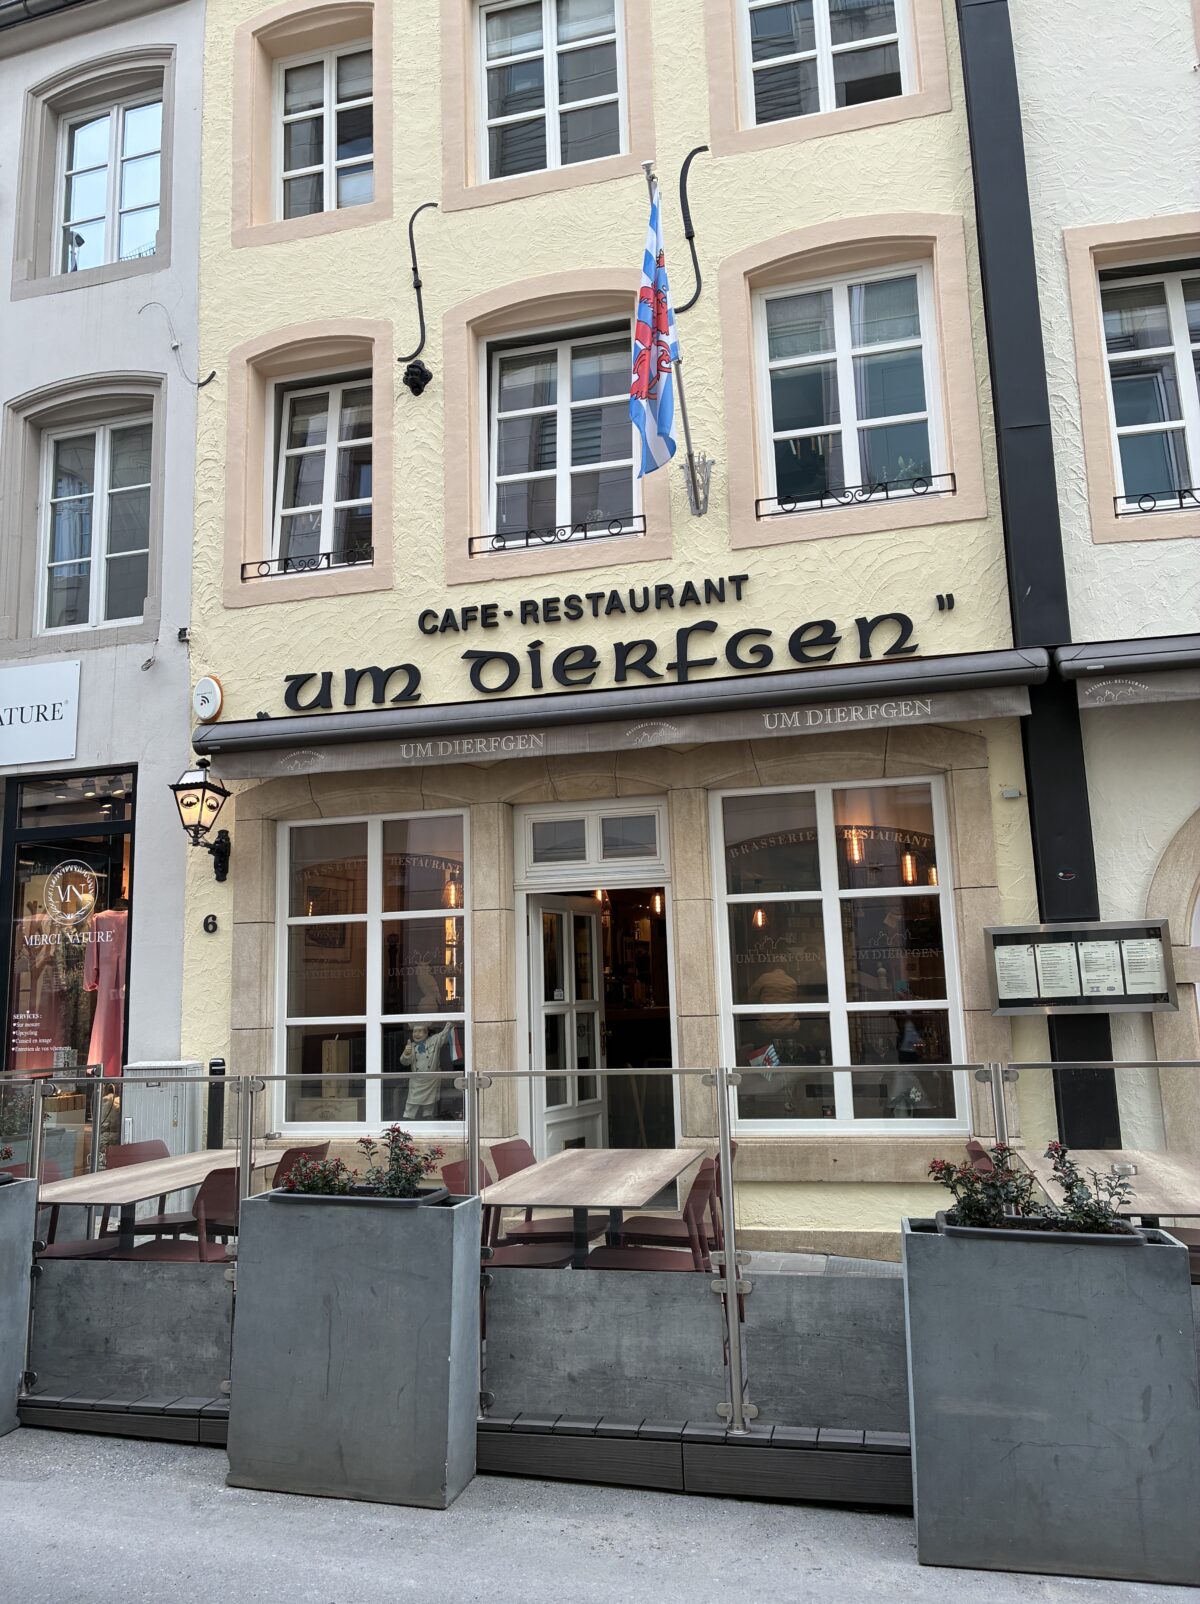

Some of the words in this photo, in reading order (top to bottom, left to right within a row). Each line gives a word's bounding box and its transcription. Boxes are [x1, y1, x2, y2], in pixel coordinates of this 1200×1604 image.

[0, 702, 64, 727] TURE
[762, 711, 801, 730] UM
[805, 699, 933, 726] DIERFGEN
[400, 742, 434, 759] UM
[437, 733, 546, 756] DIERFGEN
[729, 830, 816, 859] BRASSERIE
[842, 829, 931, 848] RESTAURANT
[391, 856, 462, 872] RESTAURANT
[203, 914, 218, 934] 6
[24, 933, 62, 946] MERCI
[64, 930, 113, 944] NATURE
